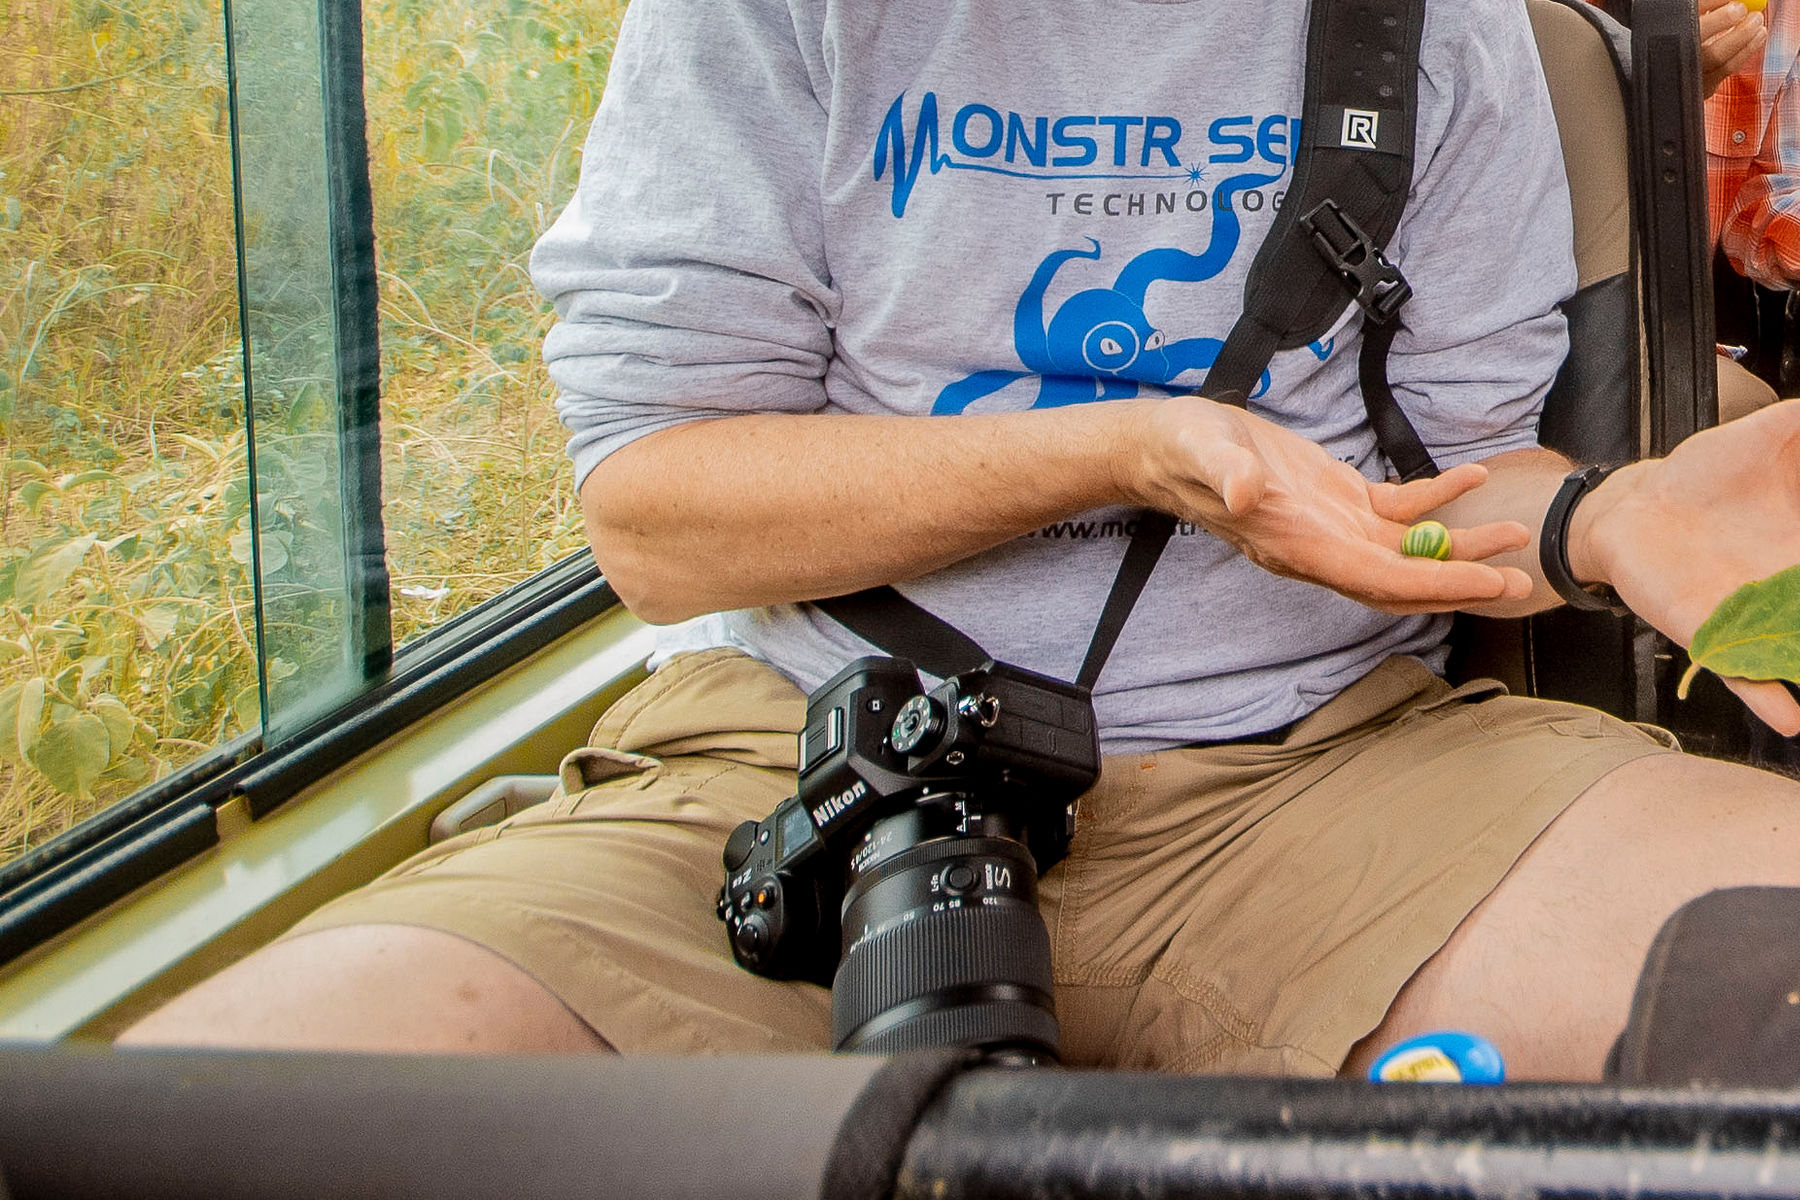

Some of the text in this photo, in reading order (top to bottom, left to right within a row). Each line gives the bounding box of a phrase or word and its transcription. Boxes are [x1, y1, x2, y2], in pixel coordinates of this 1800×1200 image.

[874, 91, 1302, 219] MONSTR SE
[1348, 114, 1378, 148] R
[812, 779, 867, 828] Nikon
